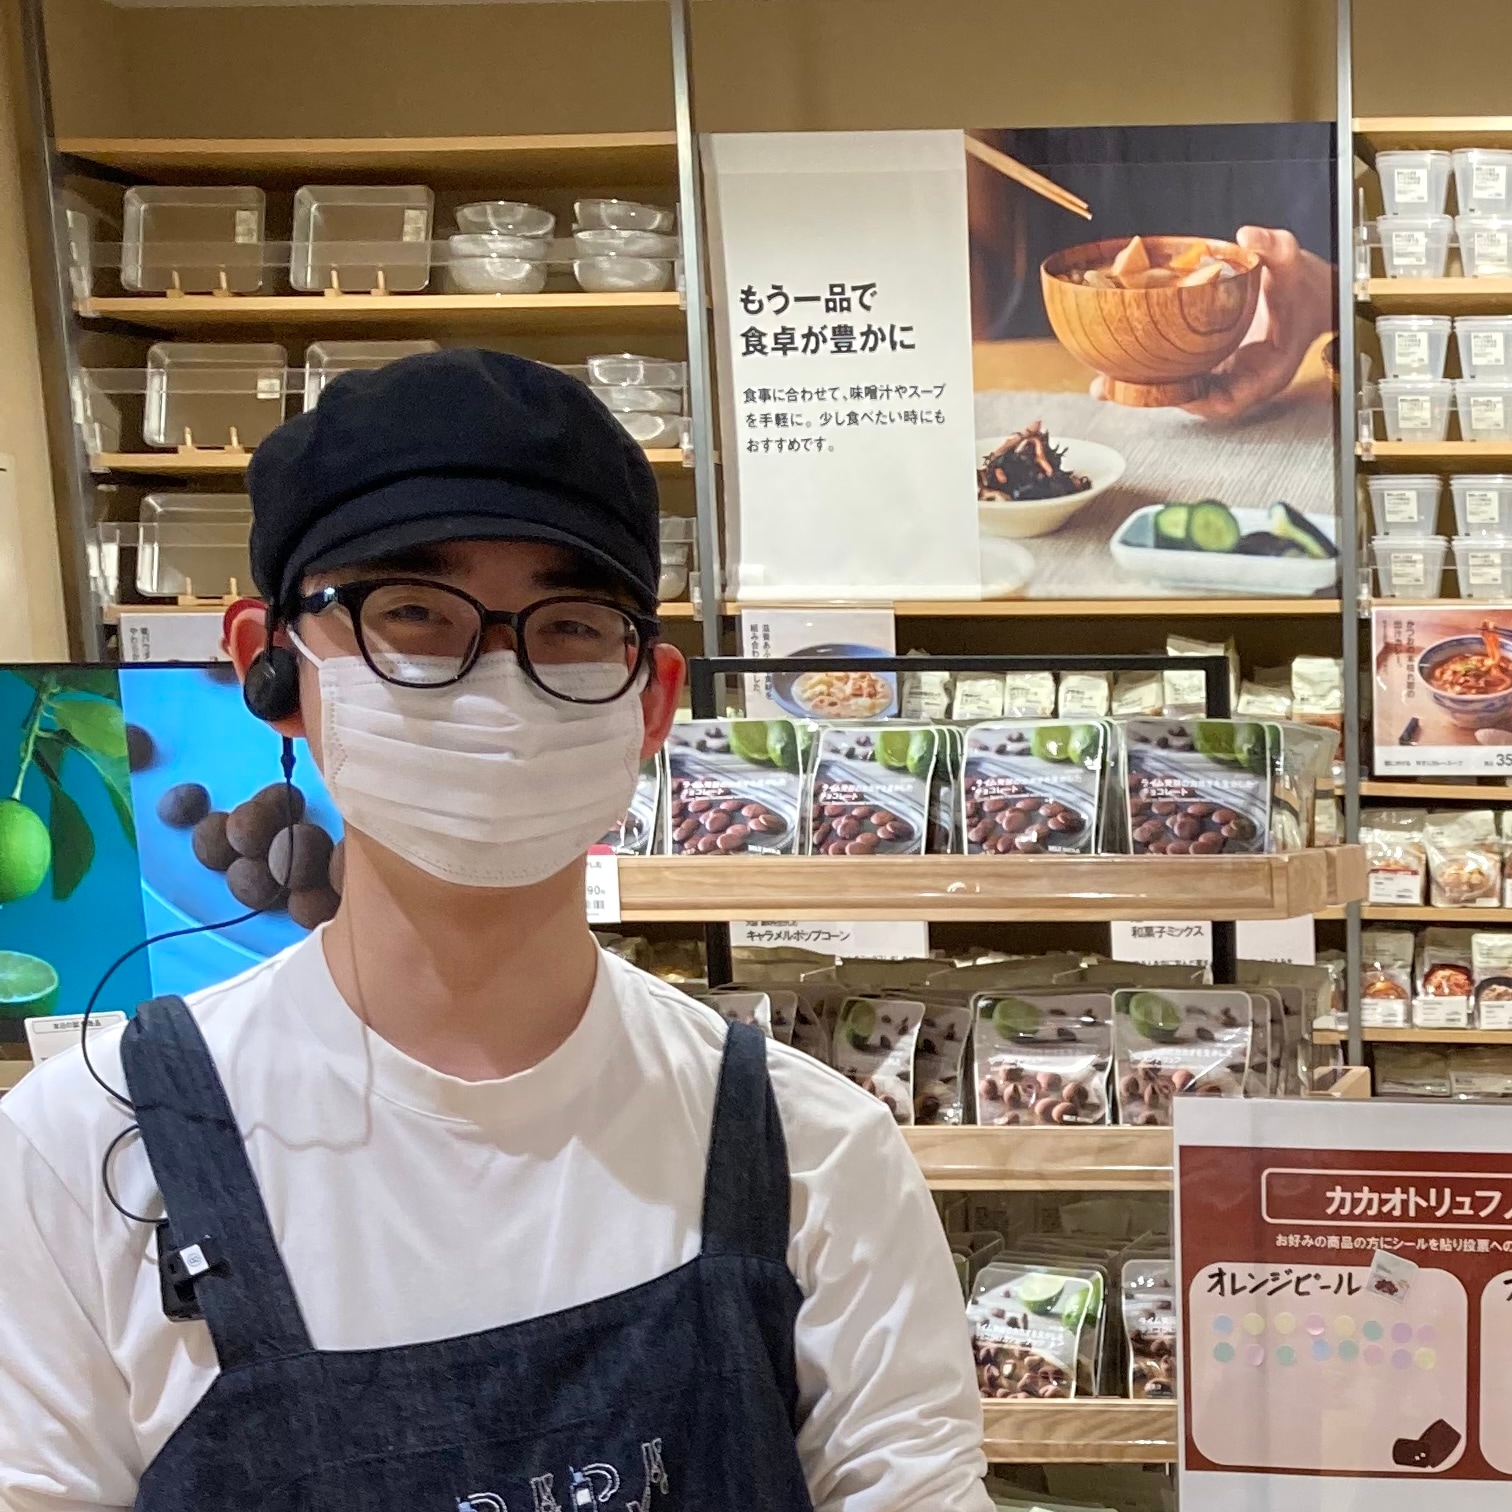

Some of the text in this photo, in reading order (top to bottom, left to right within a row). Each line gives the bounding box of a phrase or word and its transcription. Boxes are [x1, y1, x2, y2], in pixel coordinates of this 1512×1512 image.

[739, 282, 878, 315] もう一品で
[740, 323, 916, 357] 食卓が豊かに
[743, 383, 947, 404] 食事に合わせて、味噌汁やスープ
[746, 436, 834, 453] おすすめです。
[1131, 926, 1205, 938] 和菓子ミックス
[1206, 1267, 1362, 1297] オレンジピール
